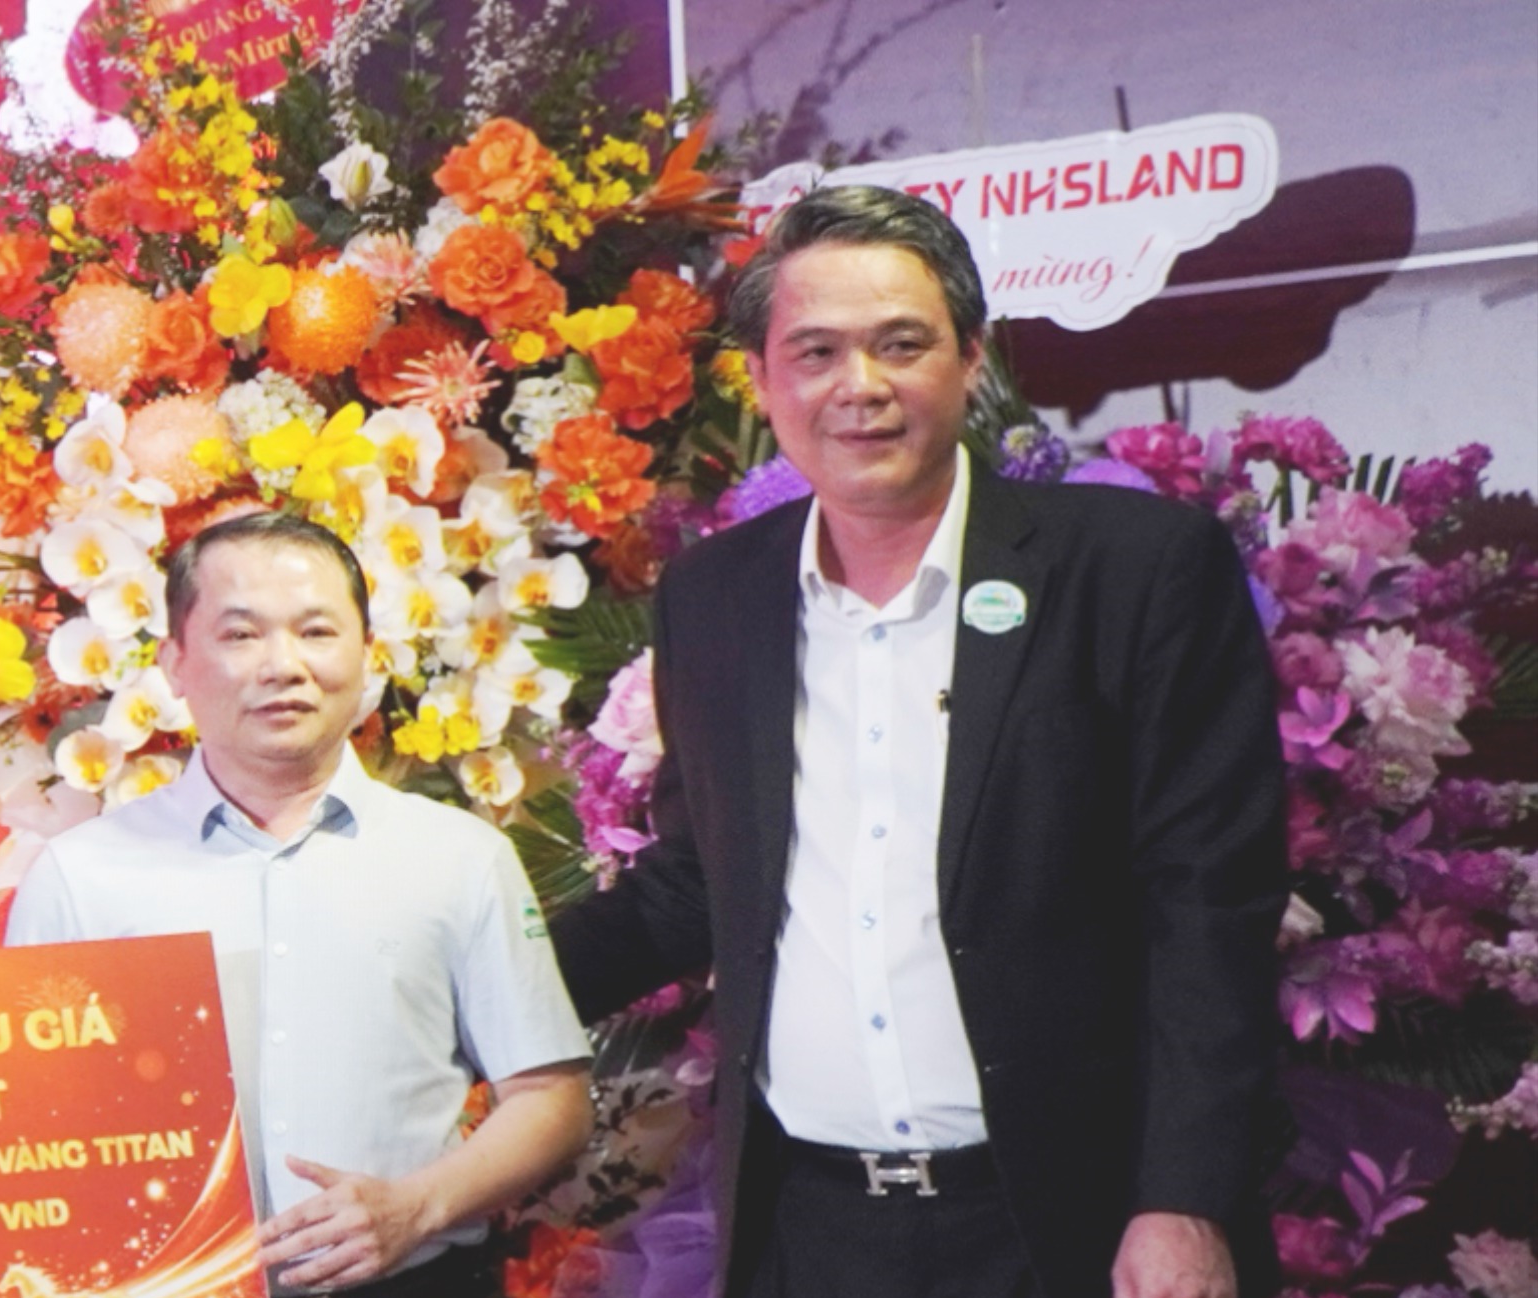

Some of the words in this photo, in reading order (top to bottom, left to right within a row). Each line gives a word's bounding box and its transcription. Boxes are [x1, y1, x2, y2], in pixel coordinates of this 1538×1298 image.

[979, 143, 1244, 219] NHSLAND
[23, 991, 118, 1051] GIÁ
[92, 1128, 196, 1167] TITAN
